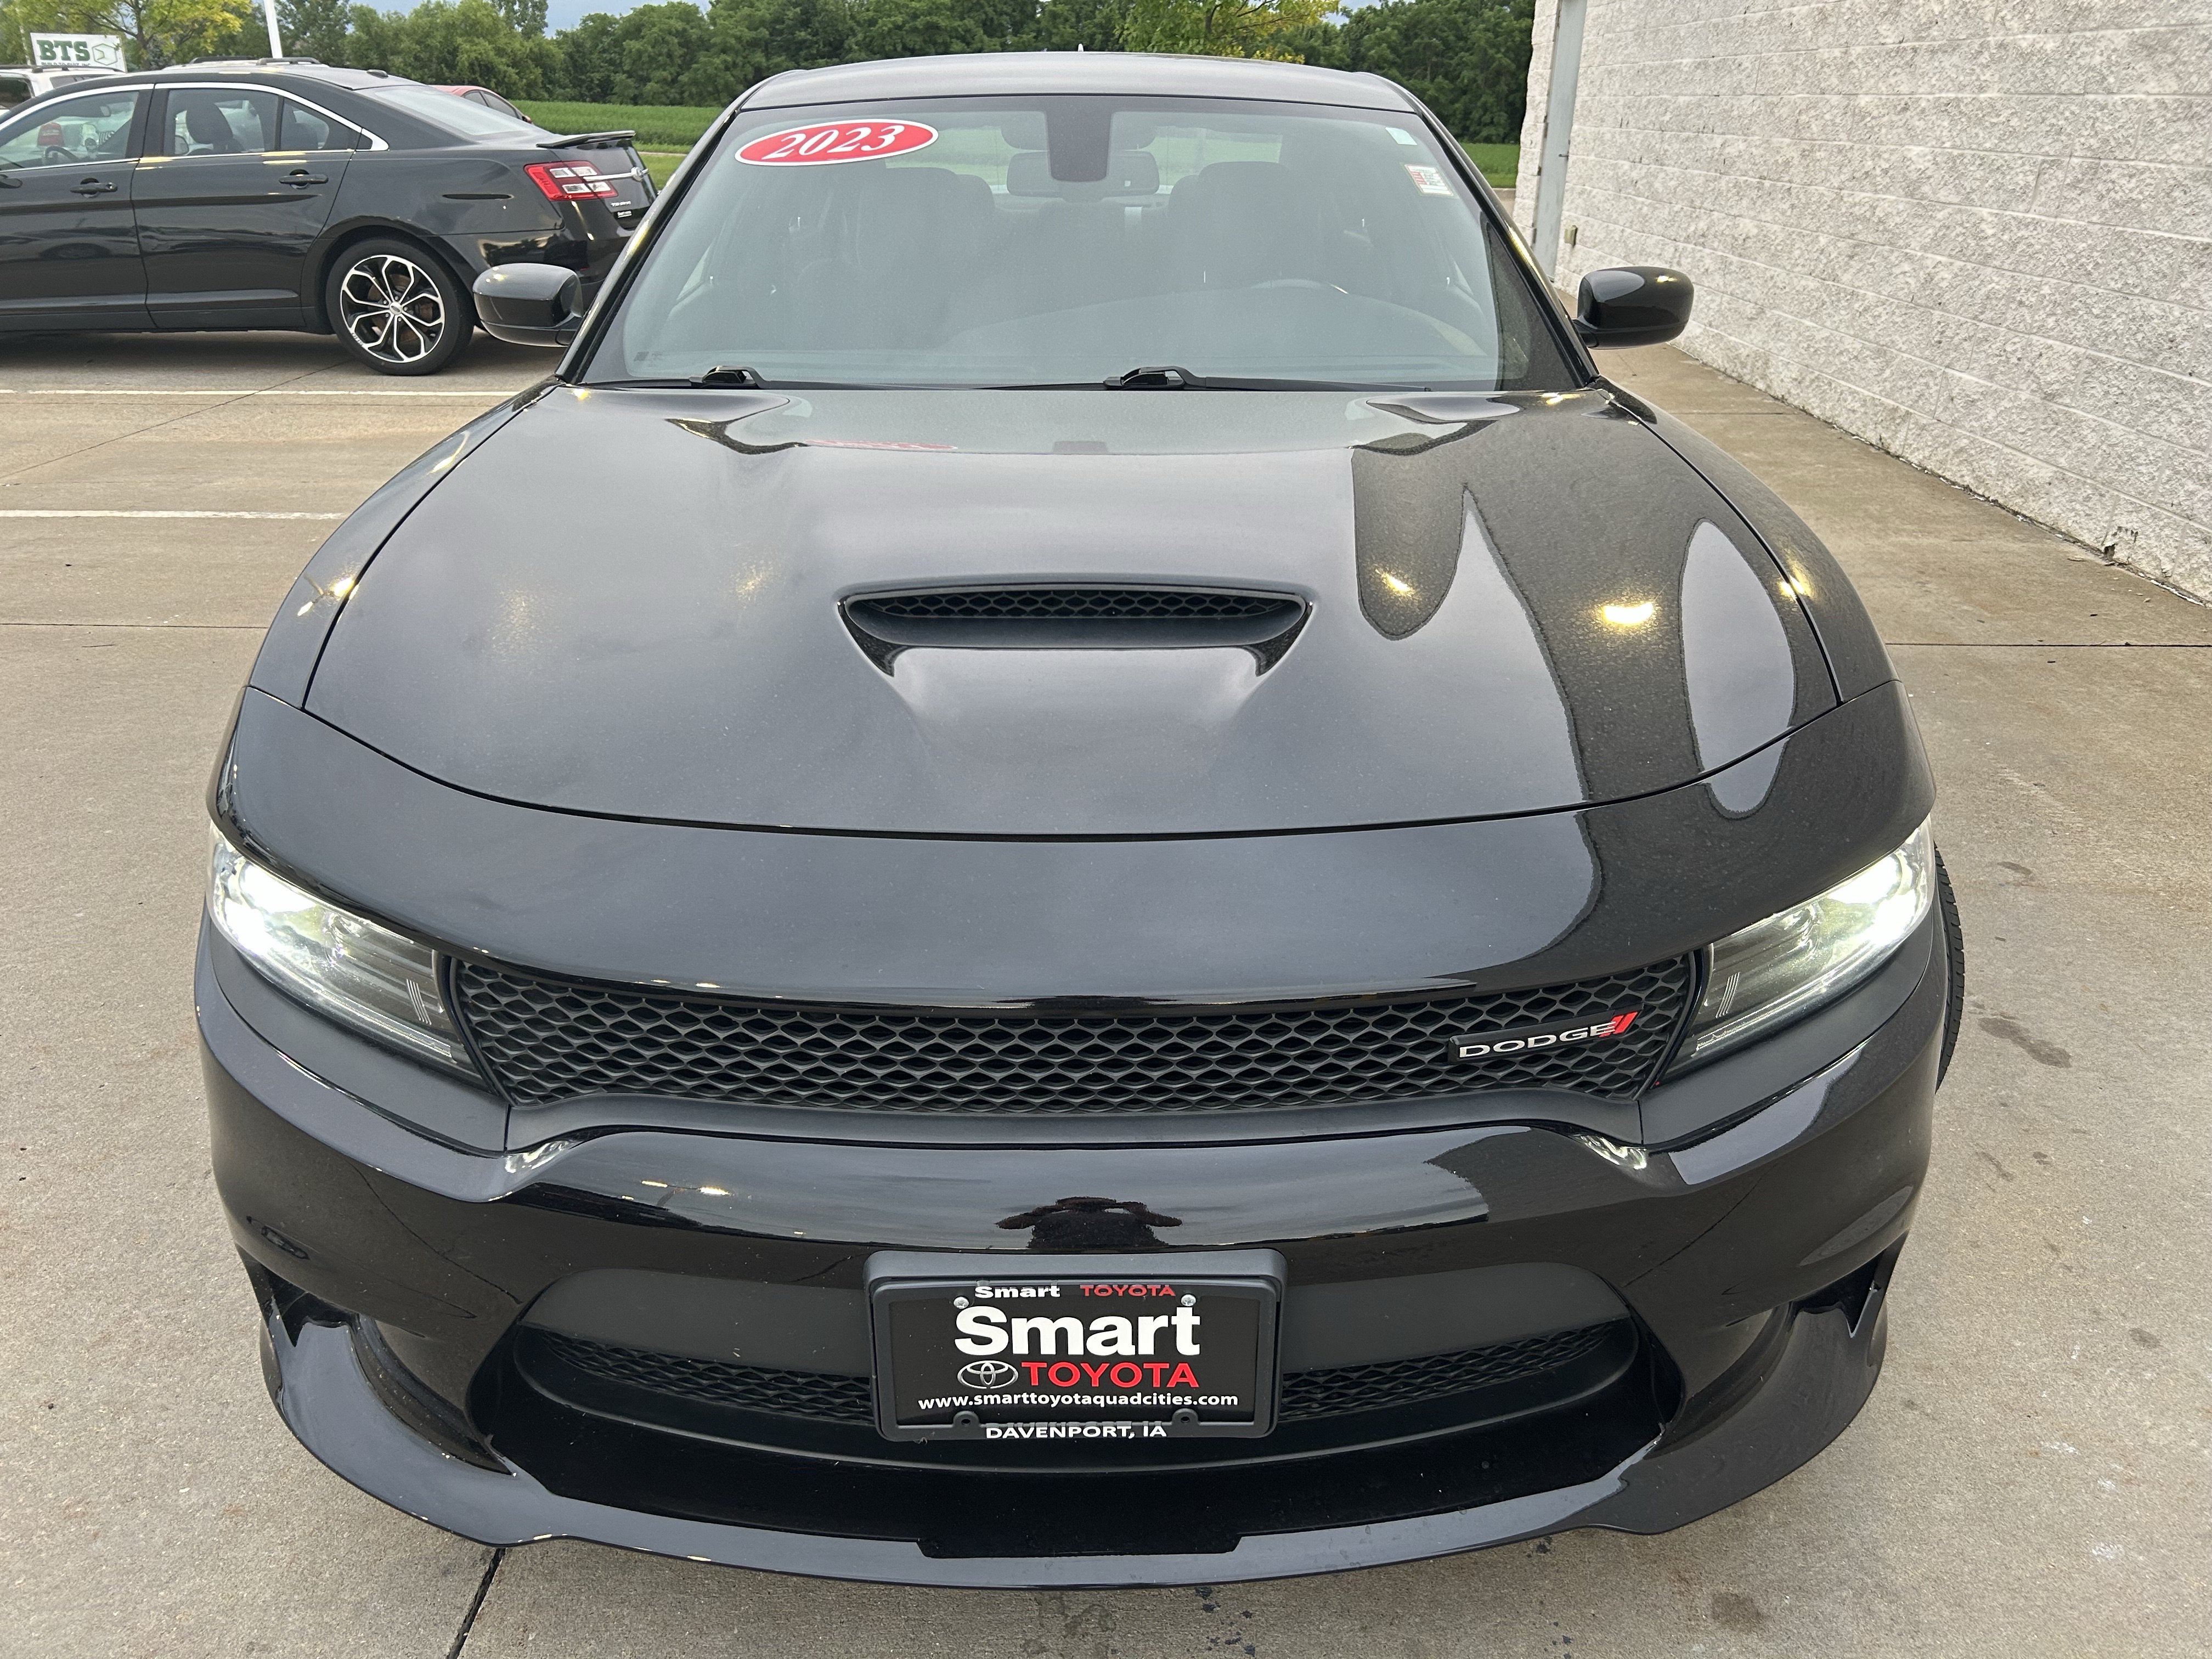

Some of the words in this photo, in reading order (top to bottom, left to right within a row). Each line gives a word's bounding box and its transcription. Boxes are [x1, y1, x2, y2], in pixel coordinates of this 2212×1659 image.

[36, 40, 91, 61] BTS
[761, 125, 905, 160] 2023
[1459, 1022, 1616, 1058] DODGE
[974, 1285, 1060, 1298] Smart
[1080, 1284, 1176, 1297] TOYOTA
[954, 1306, 1200, 1356] Smart
[1021, 1362, 1199, 1388] TOYOTA
[918, 1392, 1239, 1410] www.smarttoyotaquadcities.com
[985, 1426, 1136, 1440] DAVENPORT,
[1143, 1426, 1167, 1438] IA
